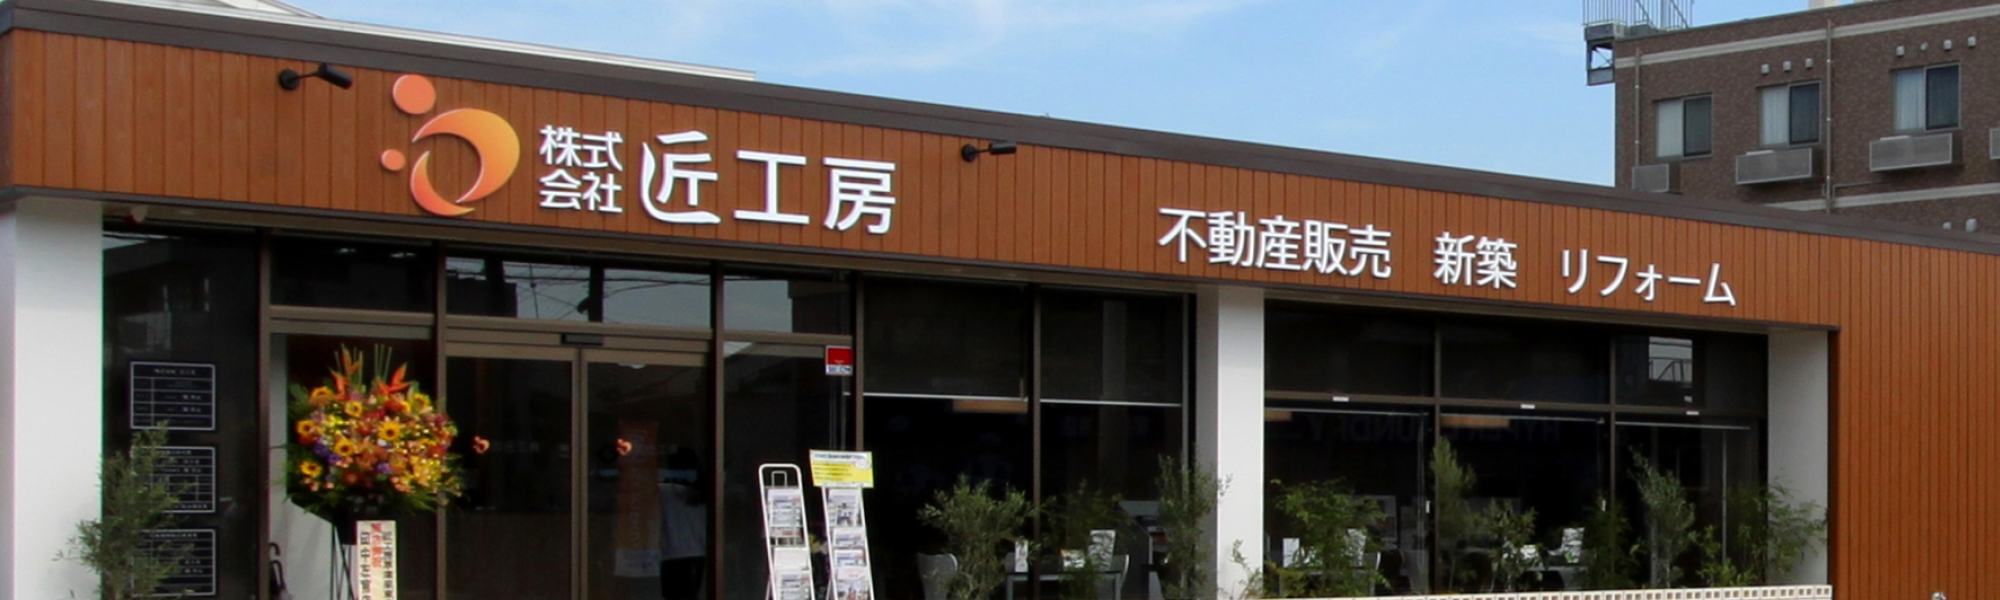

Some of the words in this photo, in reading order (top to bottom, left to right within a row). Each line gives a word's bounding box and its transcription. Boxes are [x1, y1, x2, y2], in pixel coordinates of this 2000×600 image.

[540, 124, 624, 171] 株式
[641, 130, 896, 234] 匠工房
[540, 168, 624, 213] 会社
[1158, 206, 1392, 279] 不動産販売
[1433, 231, 1518, 289] 新築
[1562, 248, 1736, 306] リフォーム
